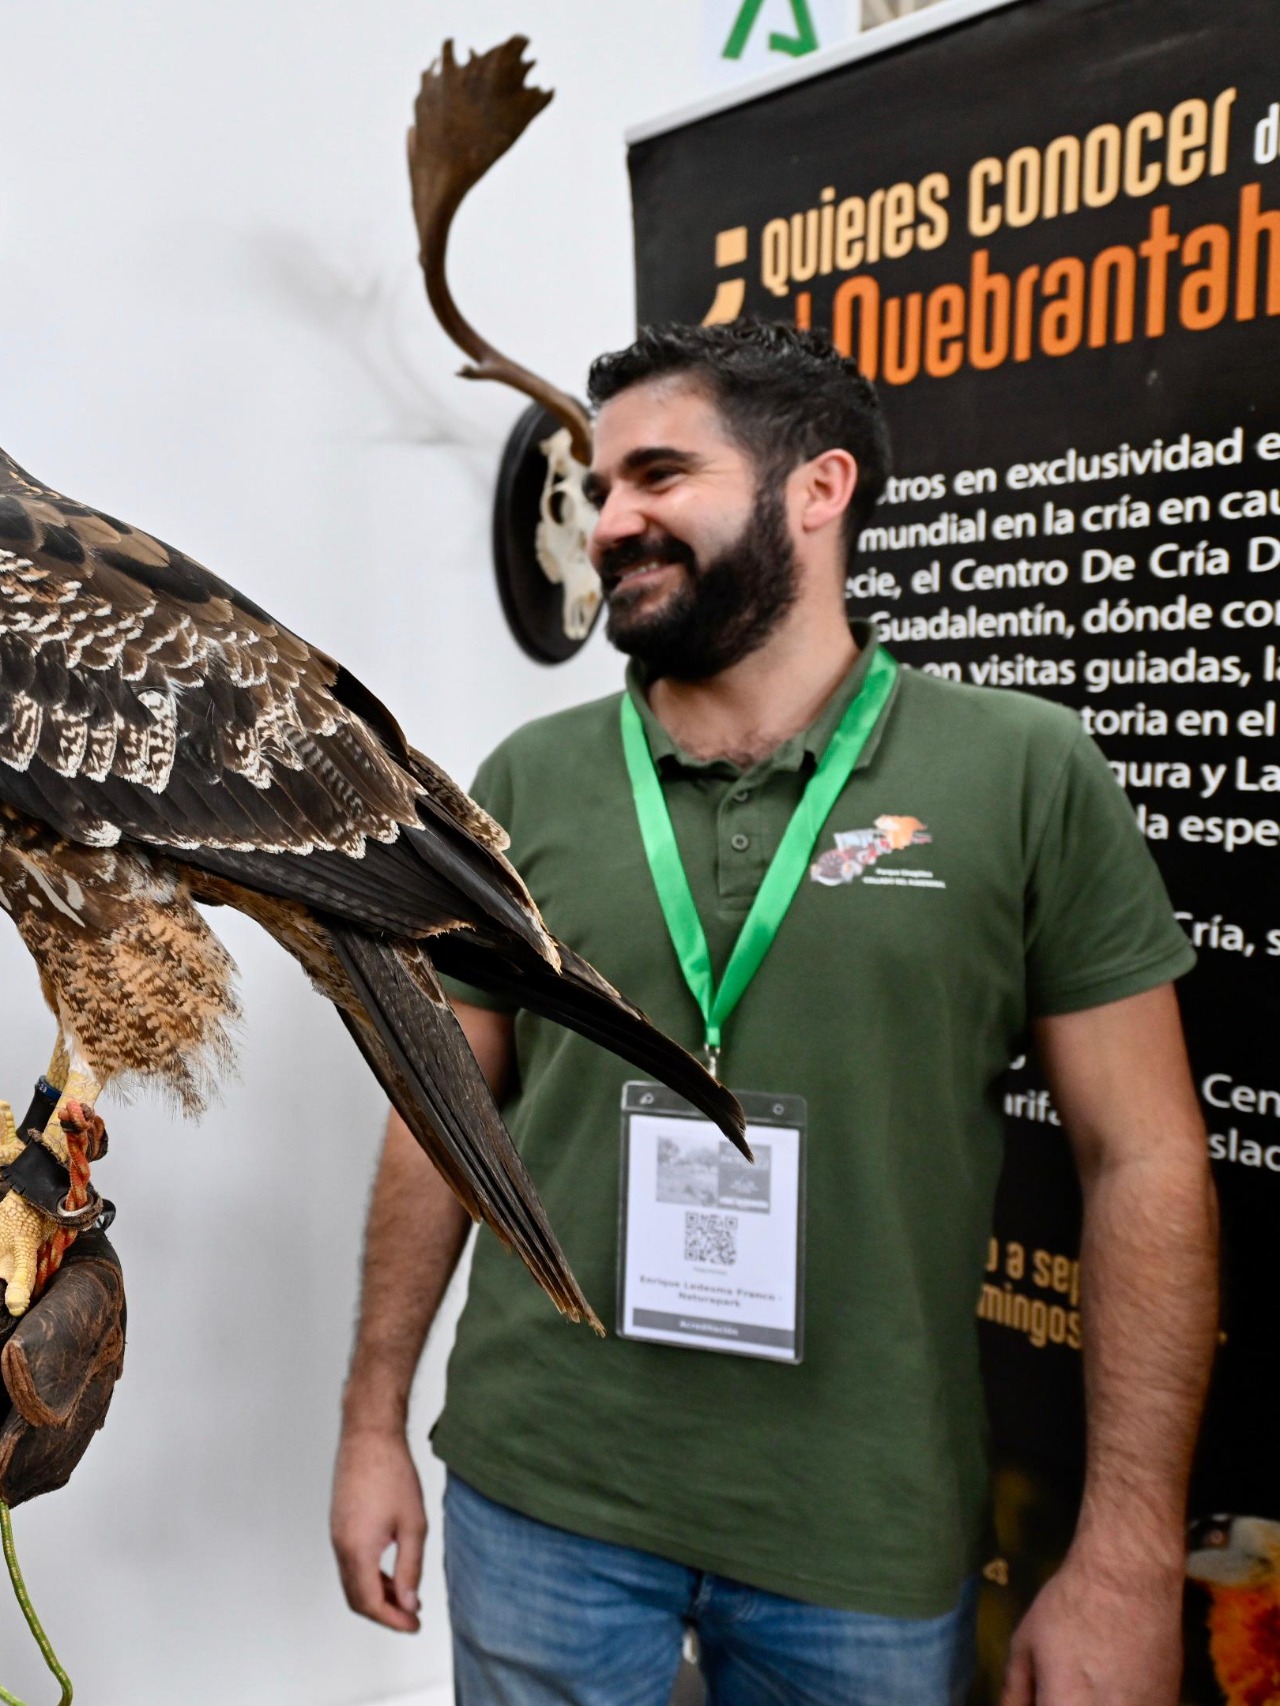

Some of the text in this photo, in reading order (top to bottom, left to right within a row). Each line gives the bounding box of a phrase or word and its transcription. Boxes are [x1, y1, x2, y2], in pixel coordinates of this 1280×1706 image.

[969, 86, 1238, 238] conocer
[876, 473, 947, 505] tros
[953, 467, 998, 497] en
[1005, 425, 1245, 491] exclusividad
[857, 507, 987, 553] mundial
[991, 511, 1037, 541] en
[1043, 501, 1076, 537] la
[1080, 493, 1151, 533] cría
[1158, 494, 1211, 526] en
[910, 559, 941, 596] el
[950, 557, 1070, 592] Centro
[1081, 548, 1136, 584] De
[1148, 539, 1230, 579] Cría
[869, 593, 1280, 643] Guadalentín, dónde co
[969, 652, 1077, 687] visitas
[1084, 646, 1252, 693] guiadas,
[1175, 709, 1229, 737] en
[1236, 699, 1277, 738] el
[1199, 762, 1228, 799] y
[1136, 803, 1280, 853] la espe
[1201, 1072, 1280, 1119] Cen
[1006, 1241, 1025, 1280] a
